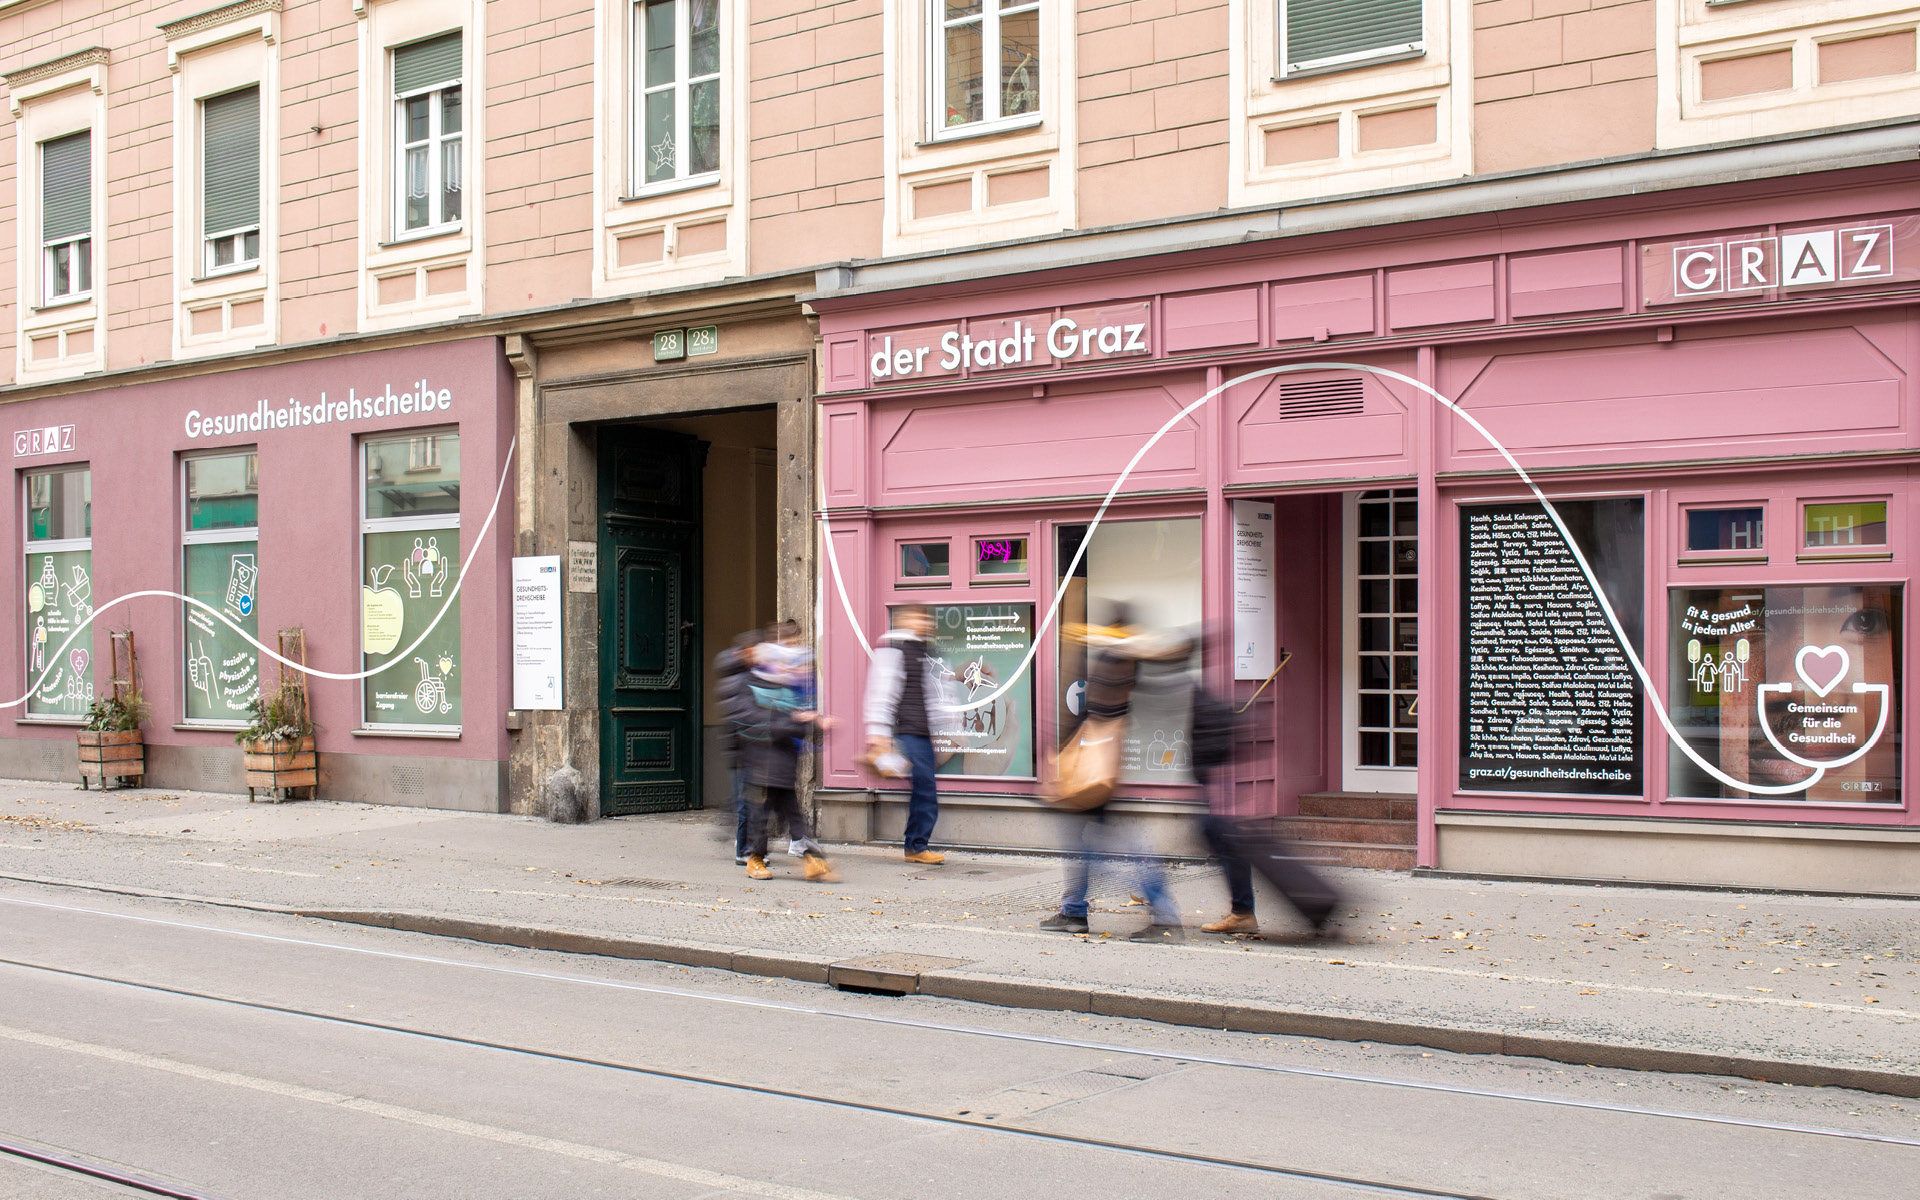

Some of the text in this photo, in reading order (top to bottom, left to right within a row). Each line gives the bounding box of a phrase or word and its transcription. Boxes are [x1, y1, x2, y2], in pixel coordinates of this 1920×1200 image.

[1678, 230, 1884, 291] GRAZ
[661, 334, 677, 351] 28
[871, 317, 1146, 377] der Stadt Graz
[185, 377, 452, 439] Gesundheitsdrehscheibe
[15, 425, 74, 455] GRAZ
[1514, 513, 1548, 521] Kalusugan,
[936, 605, 1016, 629] FOR ALL
[1686, 604, 1751, 624] fit & gesund
[1681, 618, 1756, 636] in jedem Alter
[966, 642, 1024, 650] Gesundheitsangebote
[219, 656, 256, 683] physische &
[224, 674, 258, 698] psychische
[376, 692, 408, 700] barrierefreier
[376, 702, 394, 710] Zugang
[1788, 702, 1858, 714] Gemeinsam
[1803, 718, 1842, 728] für die
[939, 730, 988, 738] Gesundheitsfragen
[1788, 732, 1856, 744] Gesundheit
[932, 738, 952, 746] ratung
[1469, 766, 1632, 780] graz.at/gesundheitsdrehscheibe
[1842, 782, 1882, 792] GRAZ
